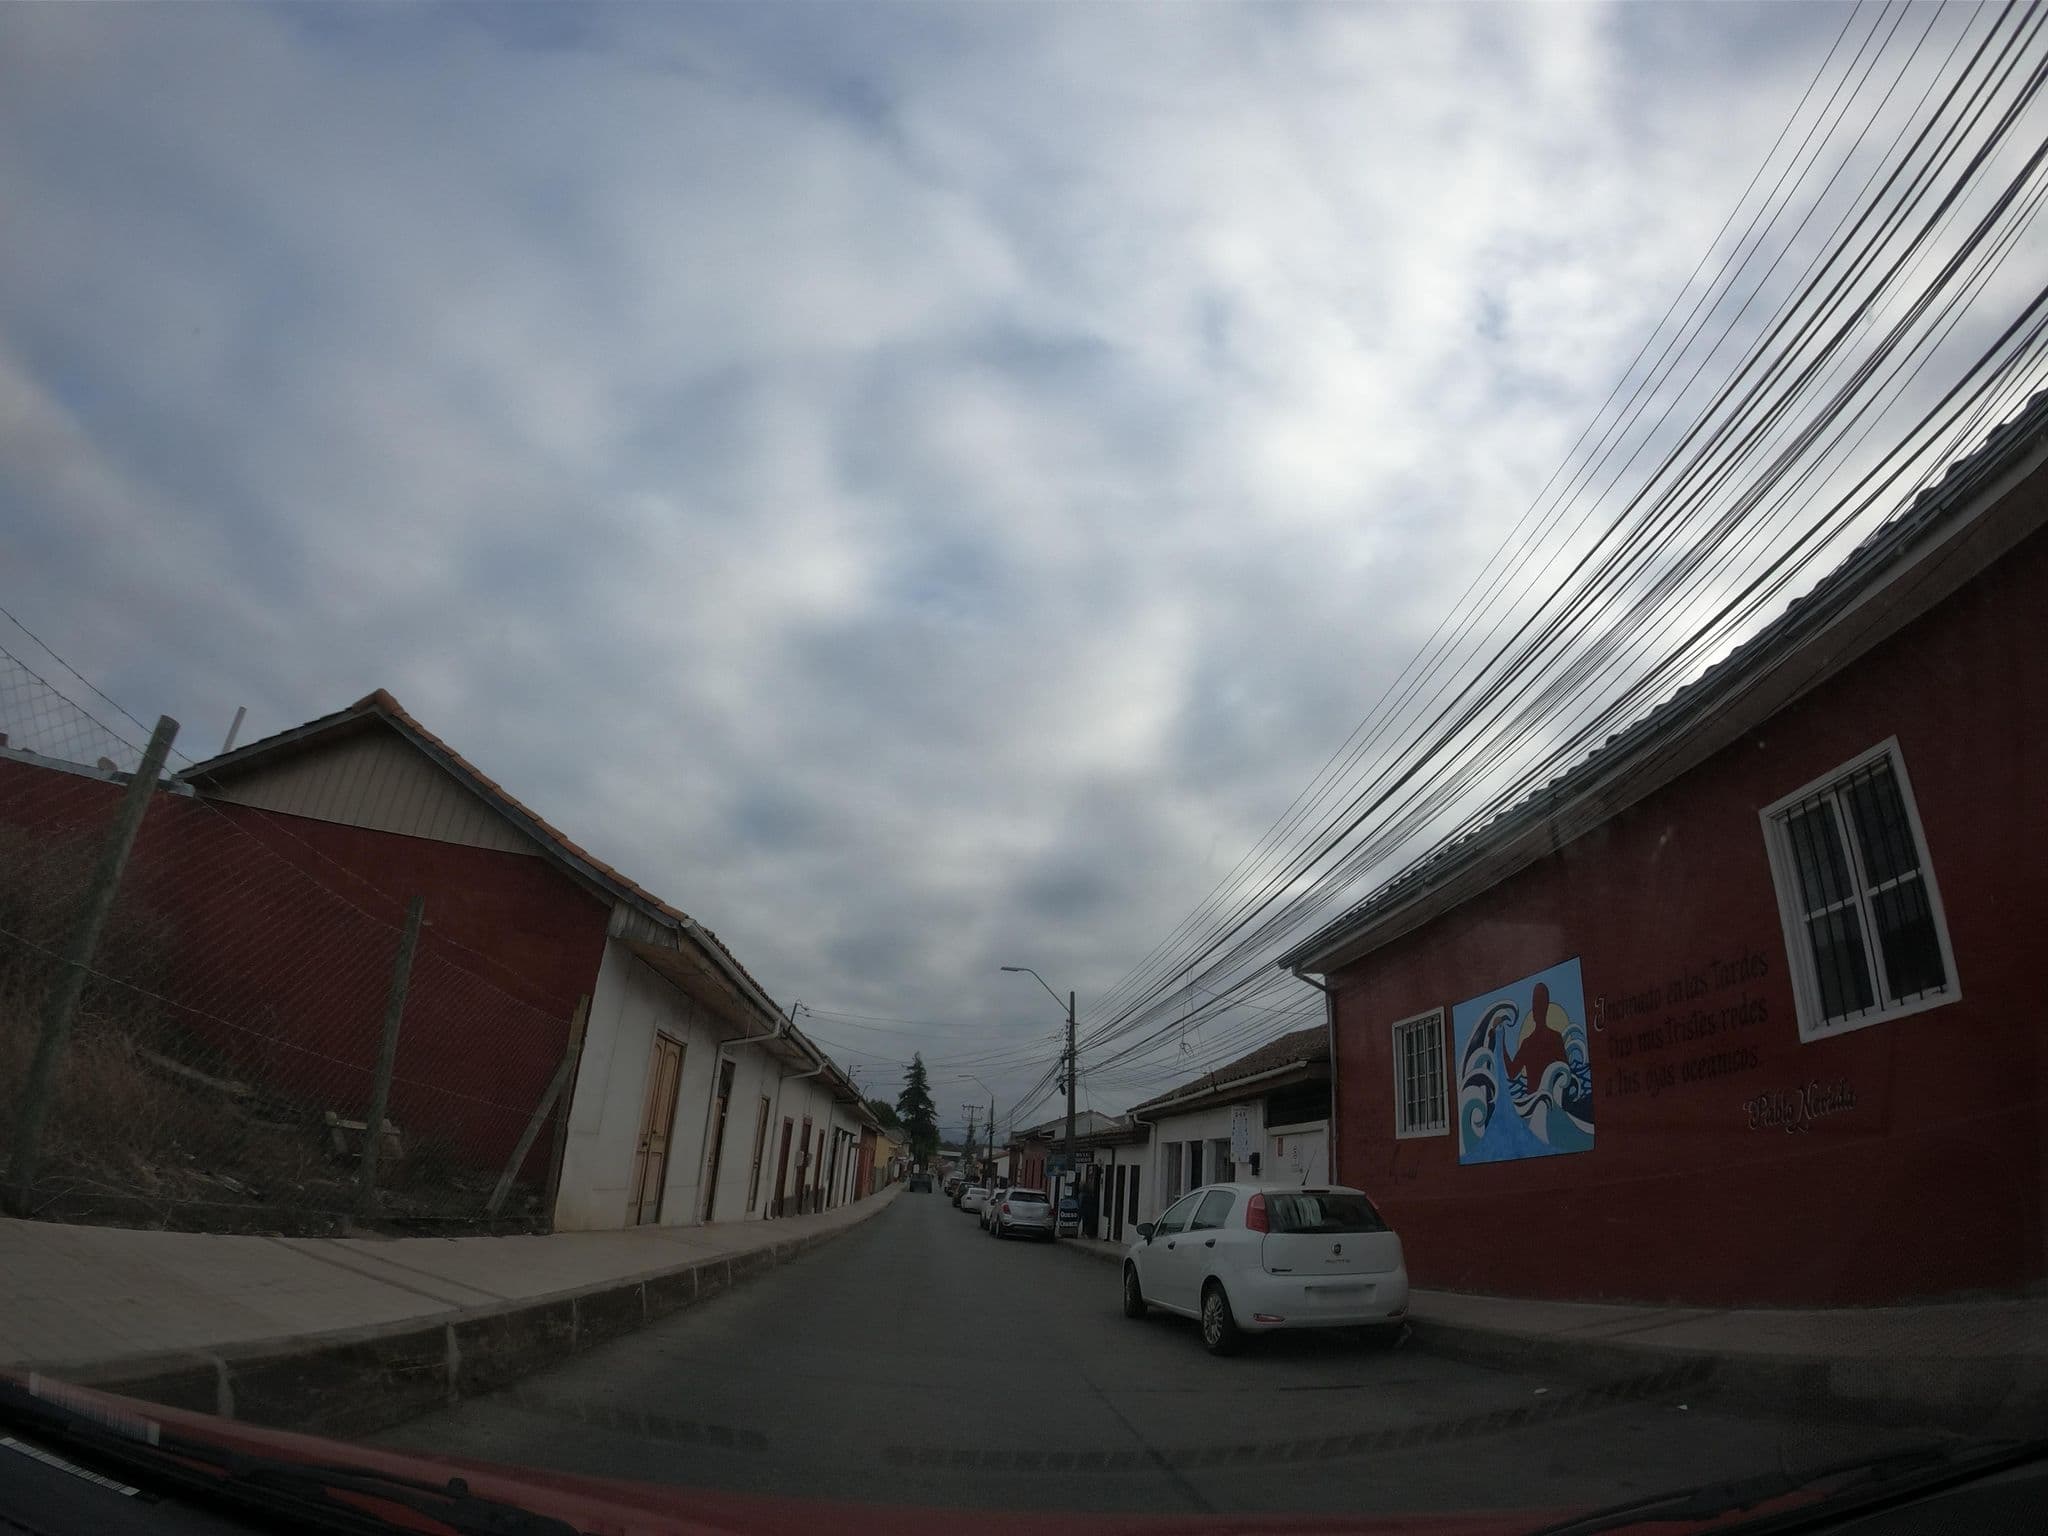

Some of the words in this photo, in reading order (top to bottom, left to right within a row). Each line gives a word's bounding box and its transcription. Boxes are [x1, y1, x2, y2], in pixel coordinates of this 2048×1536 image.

[1683, 967, 1707, 1000] las
[1719, 992, 1768, 1030] redes
[1743, 1089, 1794, 1133] Pablo
[1795, 1079, 1857, 1133] Neruda
